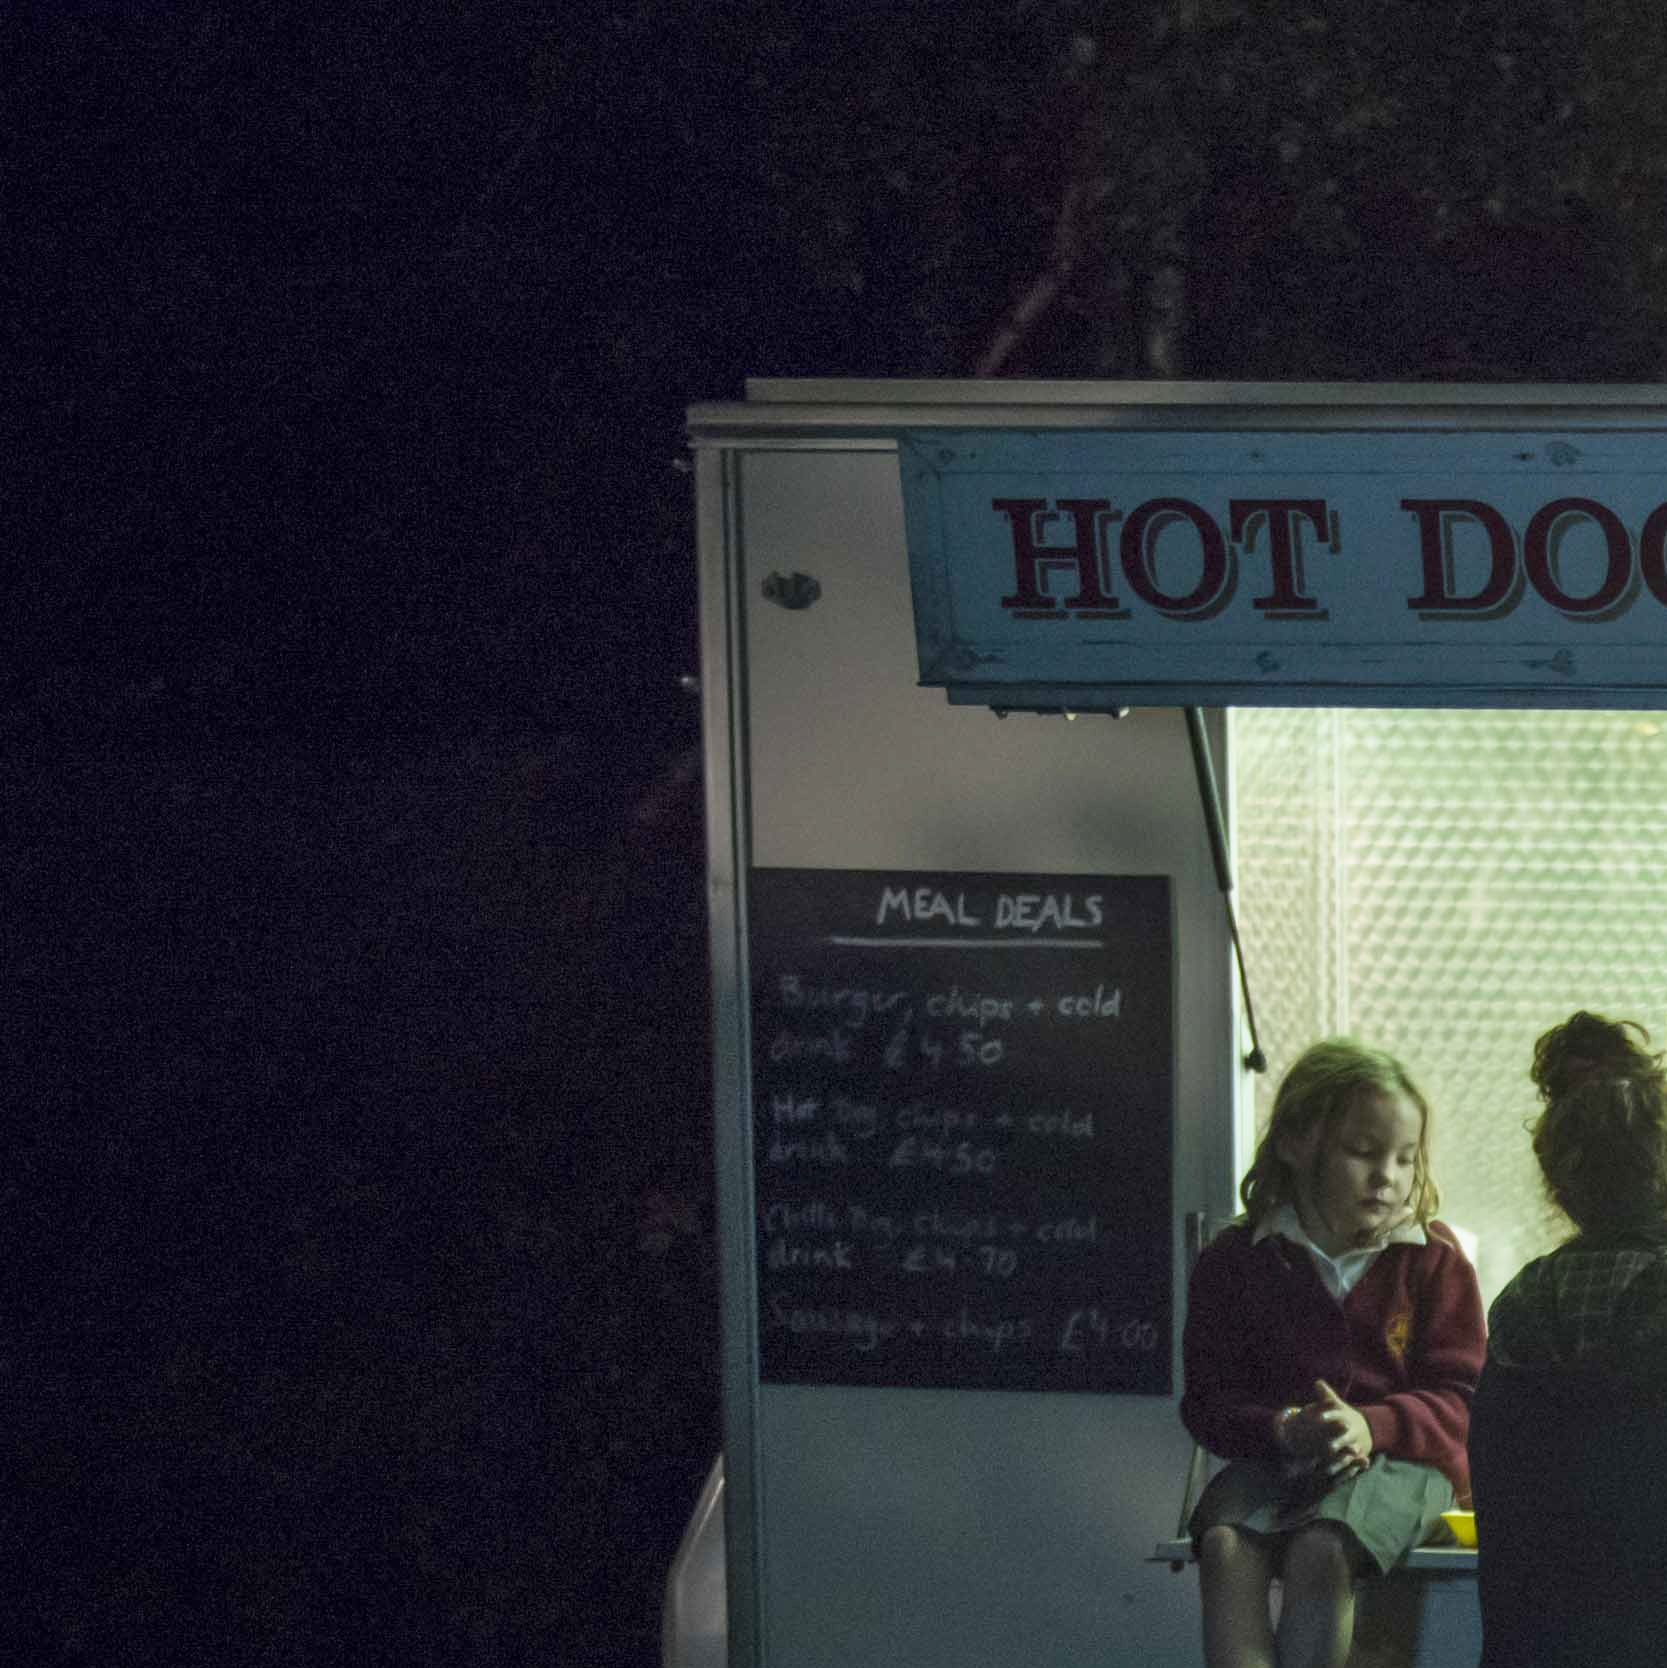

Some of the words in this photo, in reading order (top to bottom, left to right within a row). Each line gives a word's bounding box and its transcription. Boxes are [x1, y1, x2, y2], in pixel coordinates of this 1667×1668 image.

[991, 497, 1340, 620] HOT
[876, 886, 981, 926] MEAL
[994, 894, 1104, 933] DEALS
[926, 984, 1014, 1027] chips
[1057, 983, 1122, 1018] cold
[1028, 1107, 1094, 1138] cold
[768, 1237, 853, 1270] drink
